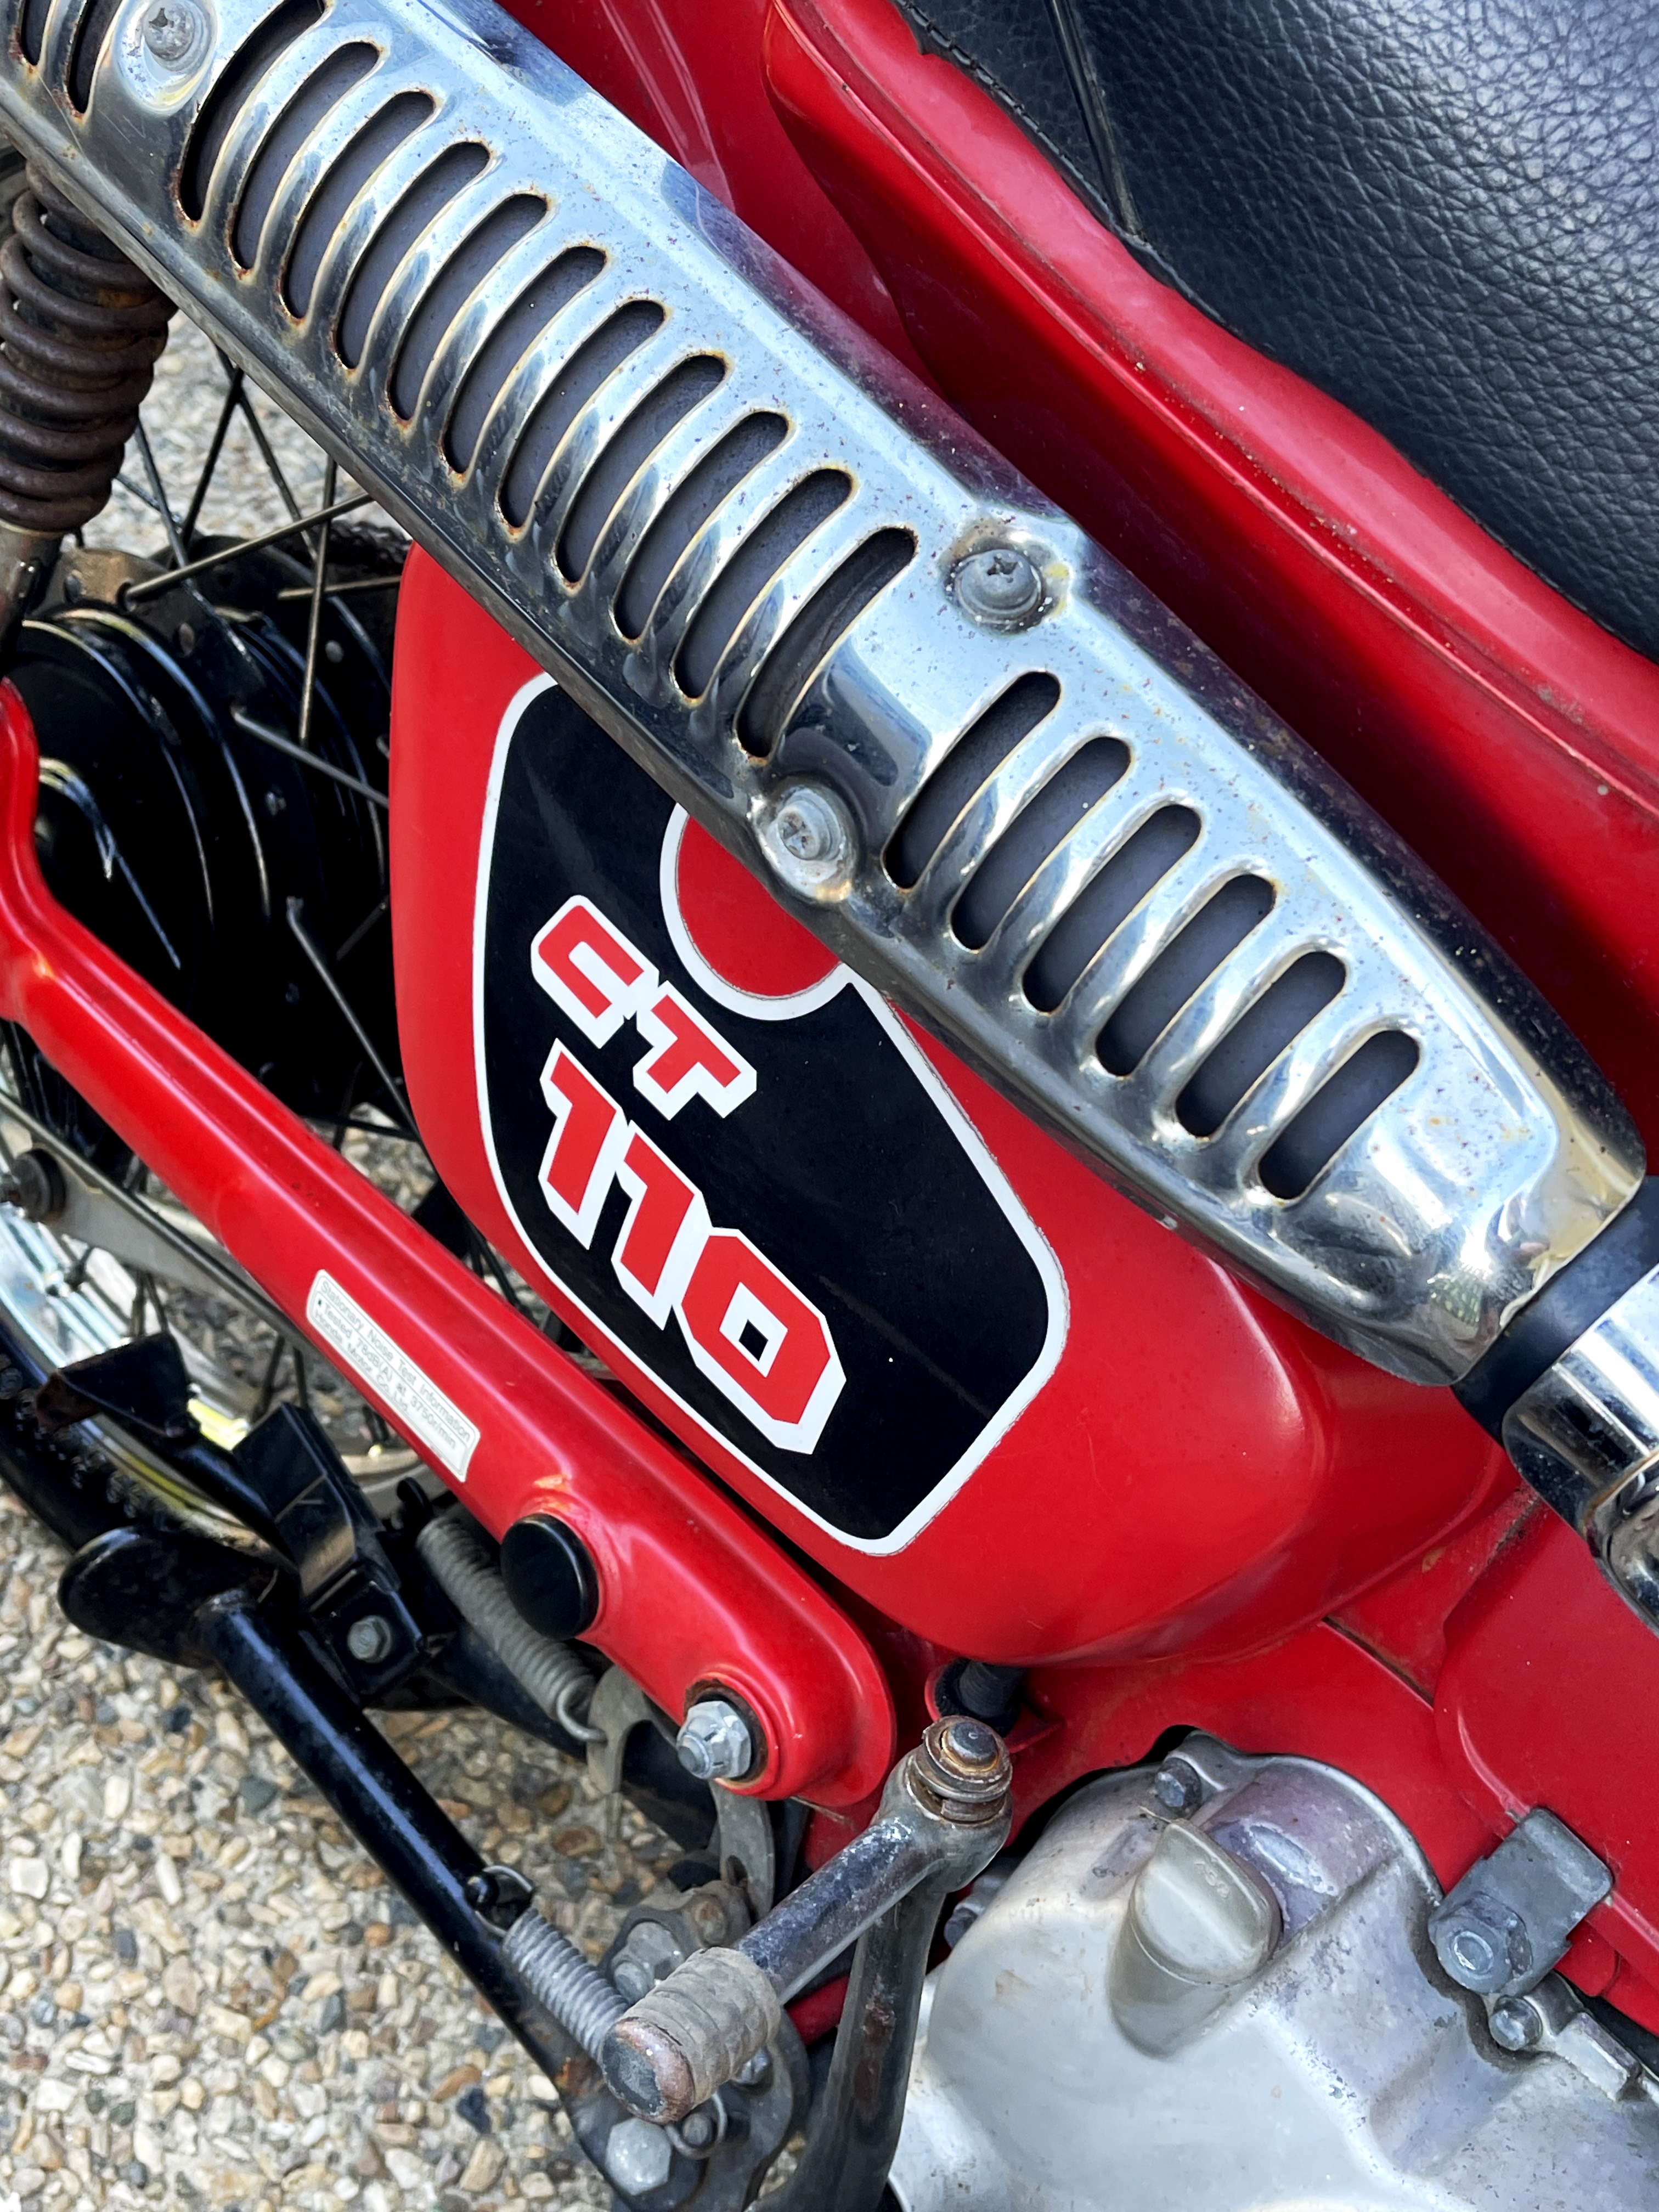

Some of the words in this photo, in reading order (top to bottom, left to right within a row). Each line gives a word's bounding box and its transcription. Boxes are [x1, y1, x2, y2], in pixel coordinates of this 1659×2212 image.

[531, 895, 757, 1119] CT
[538, 1037, 847, 1454] 110
[316, 1309, 342, 1343] Honda
[348, 1342, 372, 1372] Motor
[321, 1280, 364, 1331] Stationary
[368, 1329, 393, 1361] Noise
[398, 1358, 416, 1386] Test
[420, 1384, 471, 1443] Information
[325, 1302, 352, 1339] Tested
[357, 1338, 393, 1383] 78dB(A)
[397, 1383, 407, 1396] at
